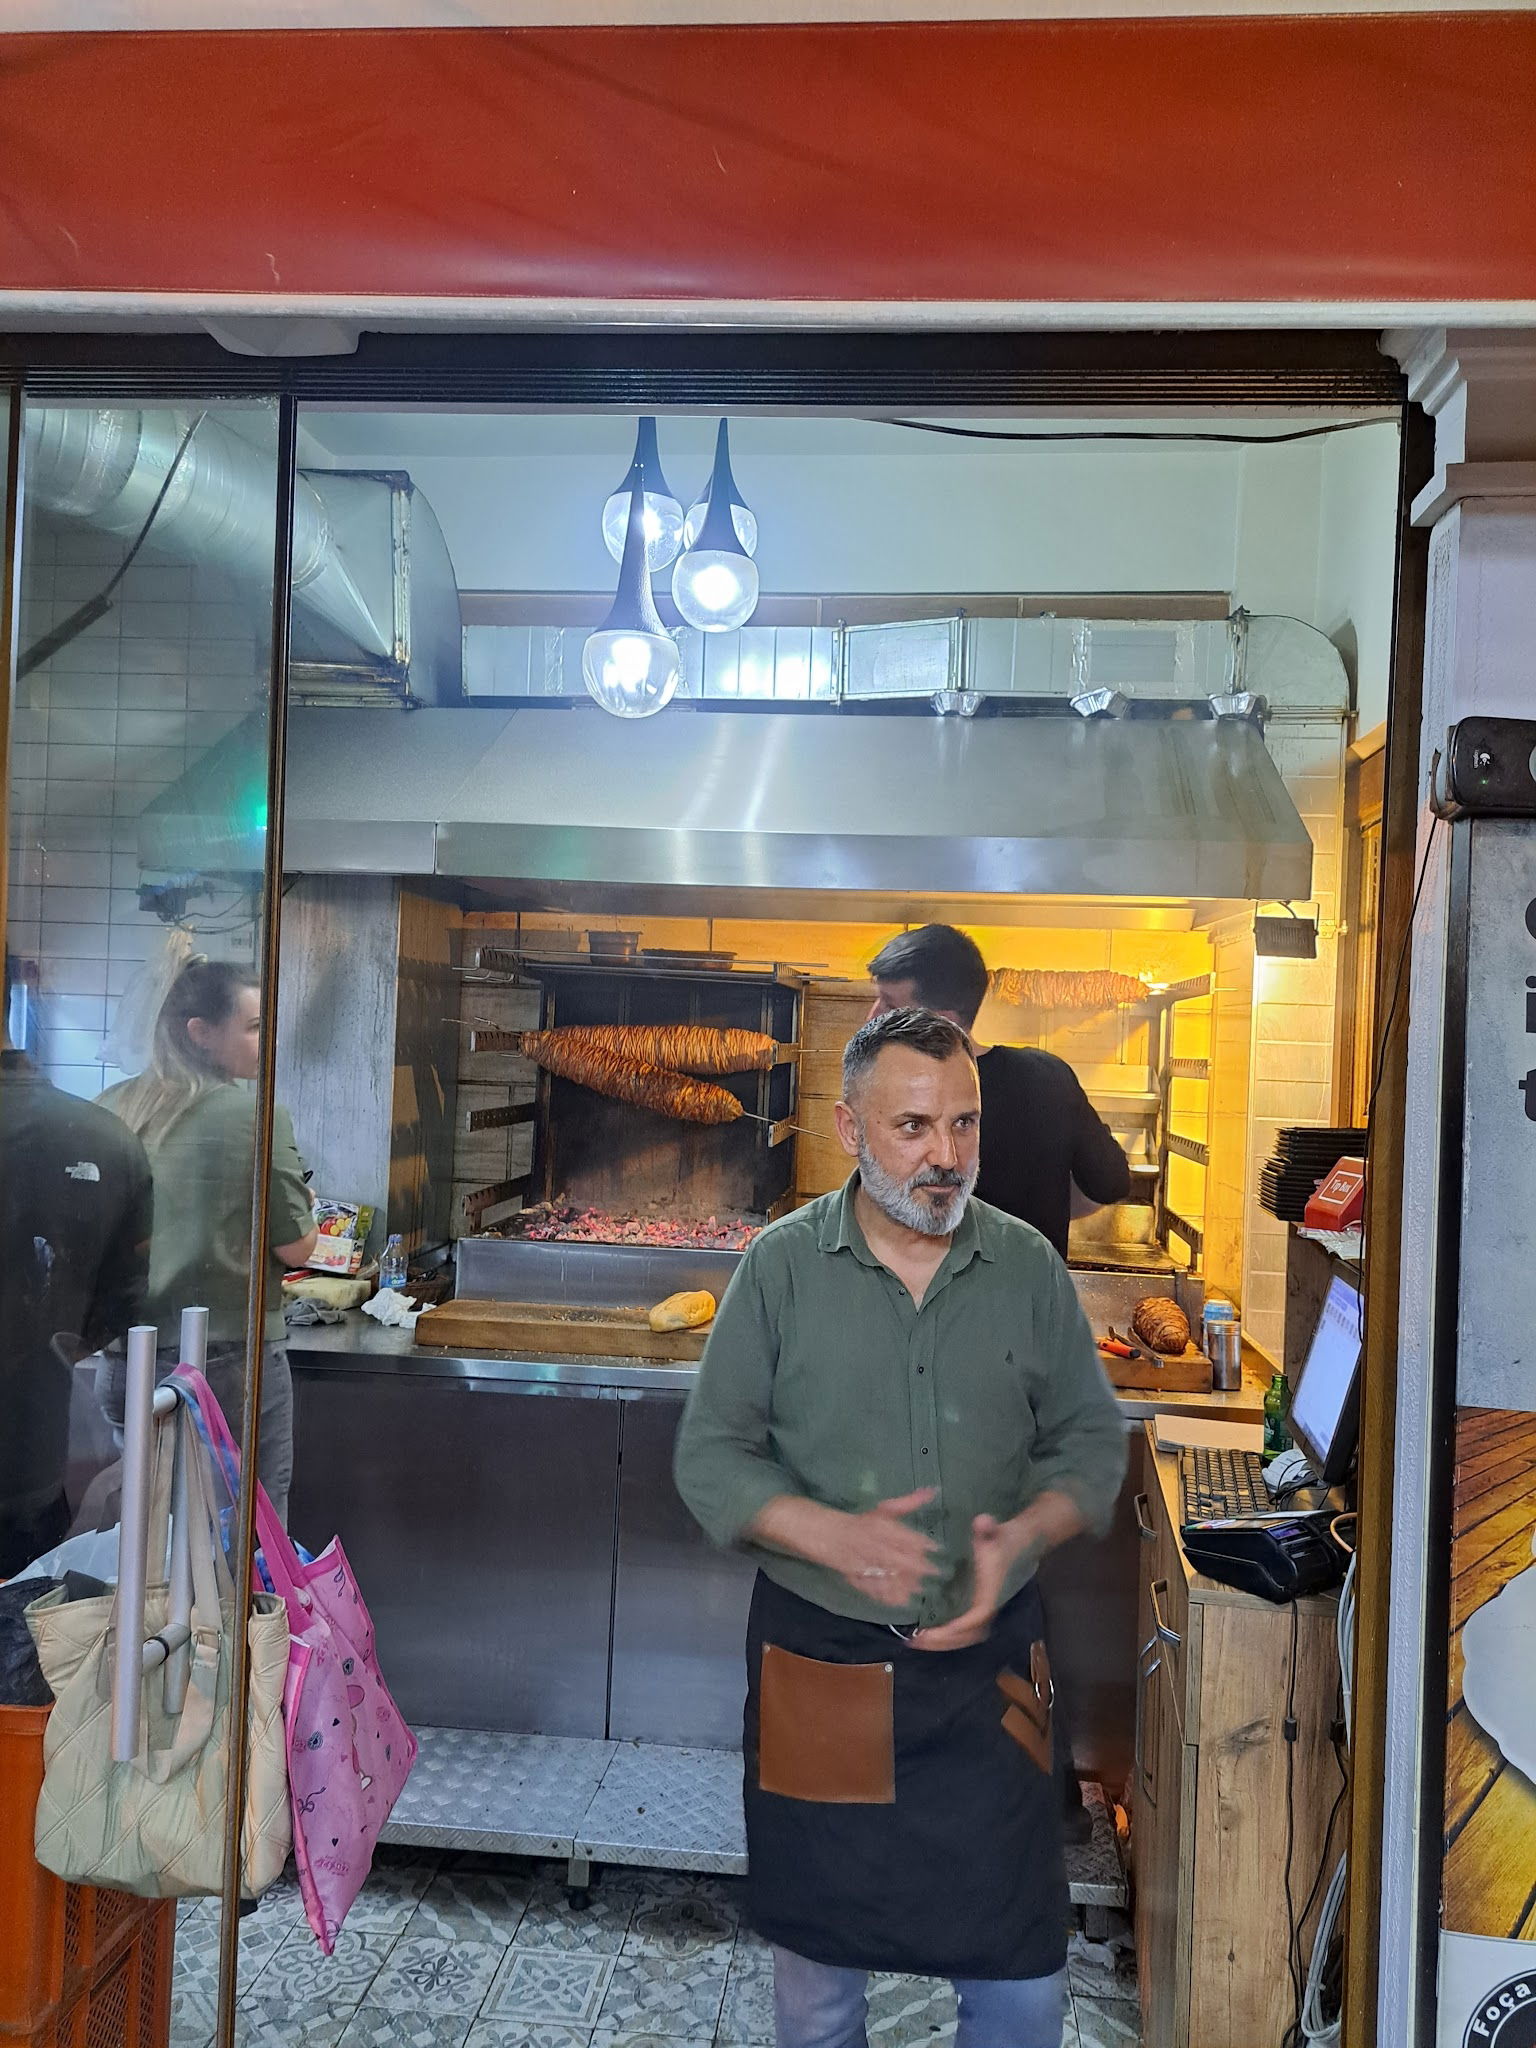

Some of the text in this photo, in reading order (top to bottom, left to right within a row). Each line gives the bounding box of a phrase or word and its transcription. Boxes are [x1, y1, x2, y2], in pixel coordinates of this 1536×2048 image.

[1330, 1179, 1353, 1193] Tip Box
[1472, 1983, 1532, 2037] Foça
